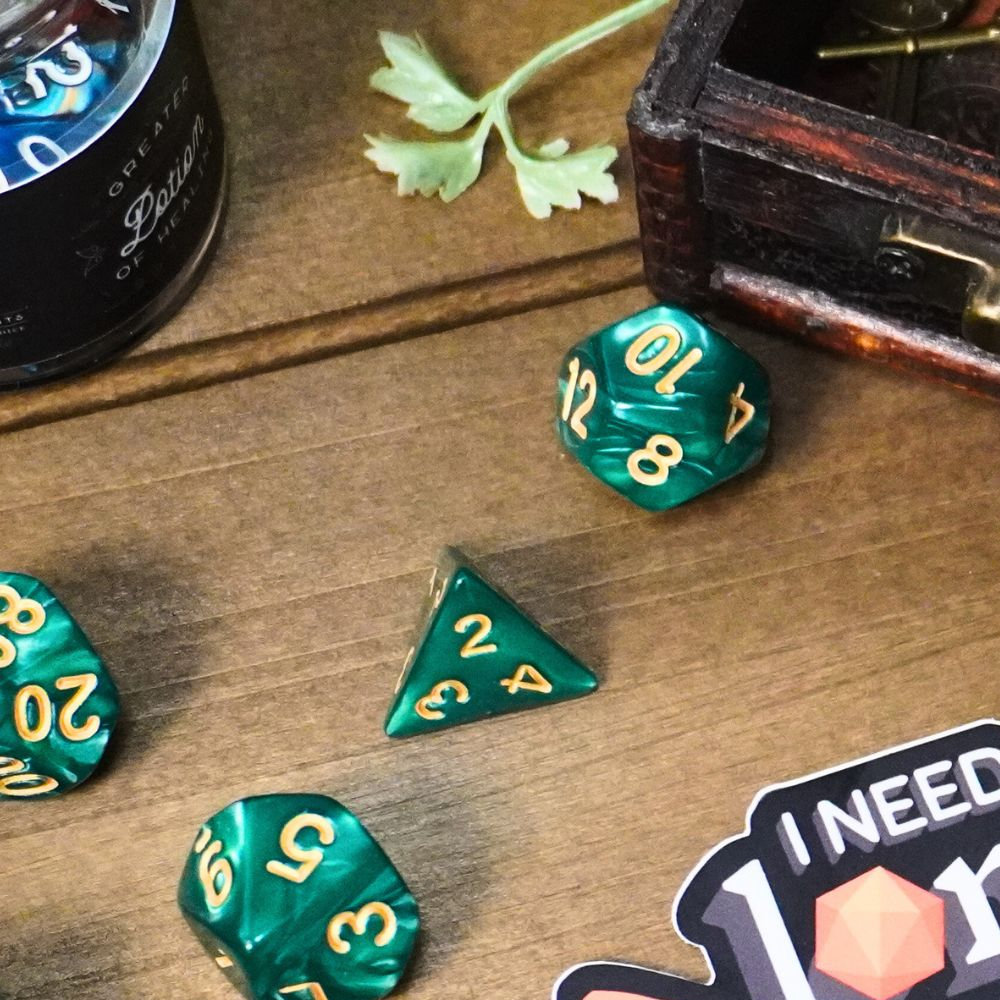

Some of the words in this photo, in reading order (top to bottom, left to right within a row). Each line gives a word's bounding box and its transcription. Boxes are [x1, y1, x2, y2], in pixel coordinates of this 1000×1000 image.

[108, 74, 190, 197] GREATER
[120, 113, 205, 258] Potion
[115, 250, 145, 281] OF
[625, 323, 703, 395] 10
[562, 356, 598, 441] 12
[725, 381, 756, 445] 4
[627, 433, 684, 487] 8
[454, 612, 498, 659] 2
[14, 672, 101, 743] 20
[415, 678, 470, 721] 3
[500, 663, 553, 695] 4
[266, 812, 335, 883] 5
[779, 811, 811, 868] I
[327, 901, 398, 954] 3
